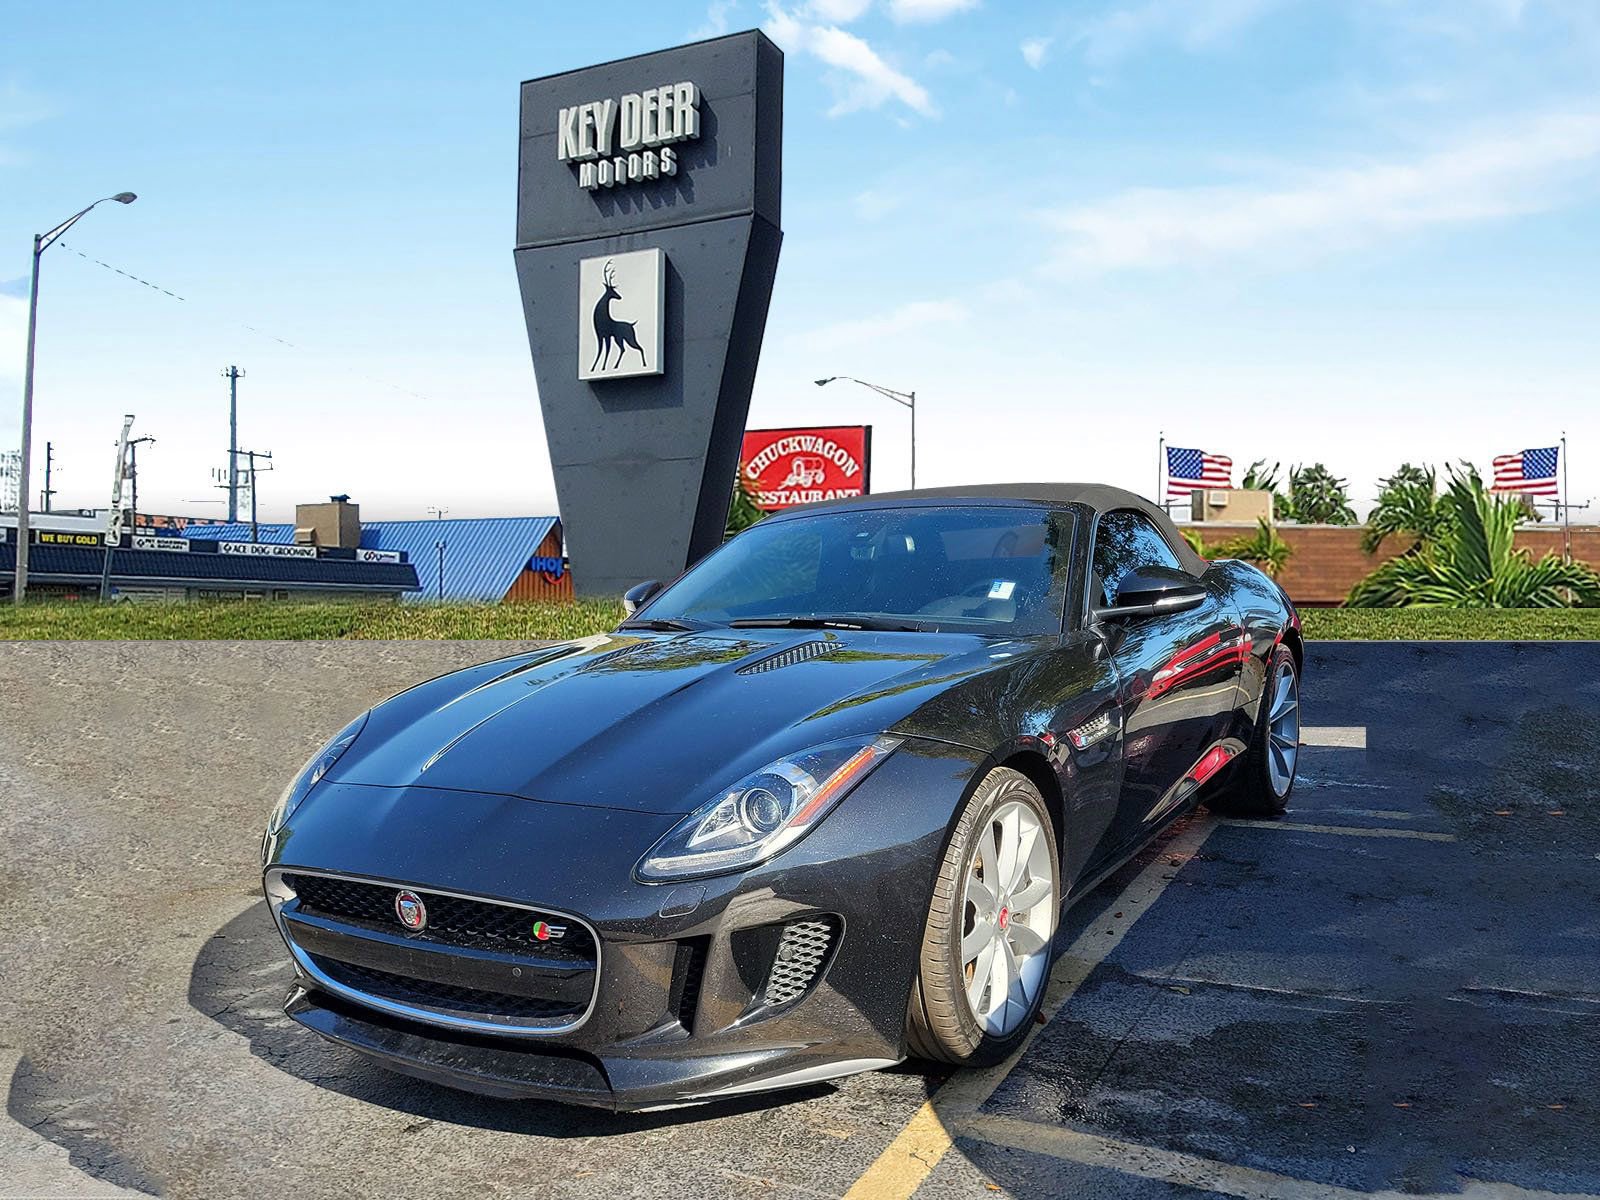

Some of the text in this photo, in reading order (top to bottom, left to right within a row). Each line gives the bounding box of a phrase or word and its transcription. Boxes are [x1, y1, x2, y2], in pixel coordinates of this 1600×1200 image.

[558, 81, 700, 163] KEY DEER
[579, 147, 677, 190] MOTORS
[745, 435, 860, 480] CHUCKWAGON
[750, 488, 861, 505] ESTAURANT
[41, 533, 98, 545] WE BUY GOLD
[233, 542, 315, 558] ACE DOG GROOMING
